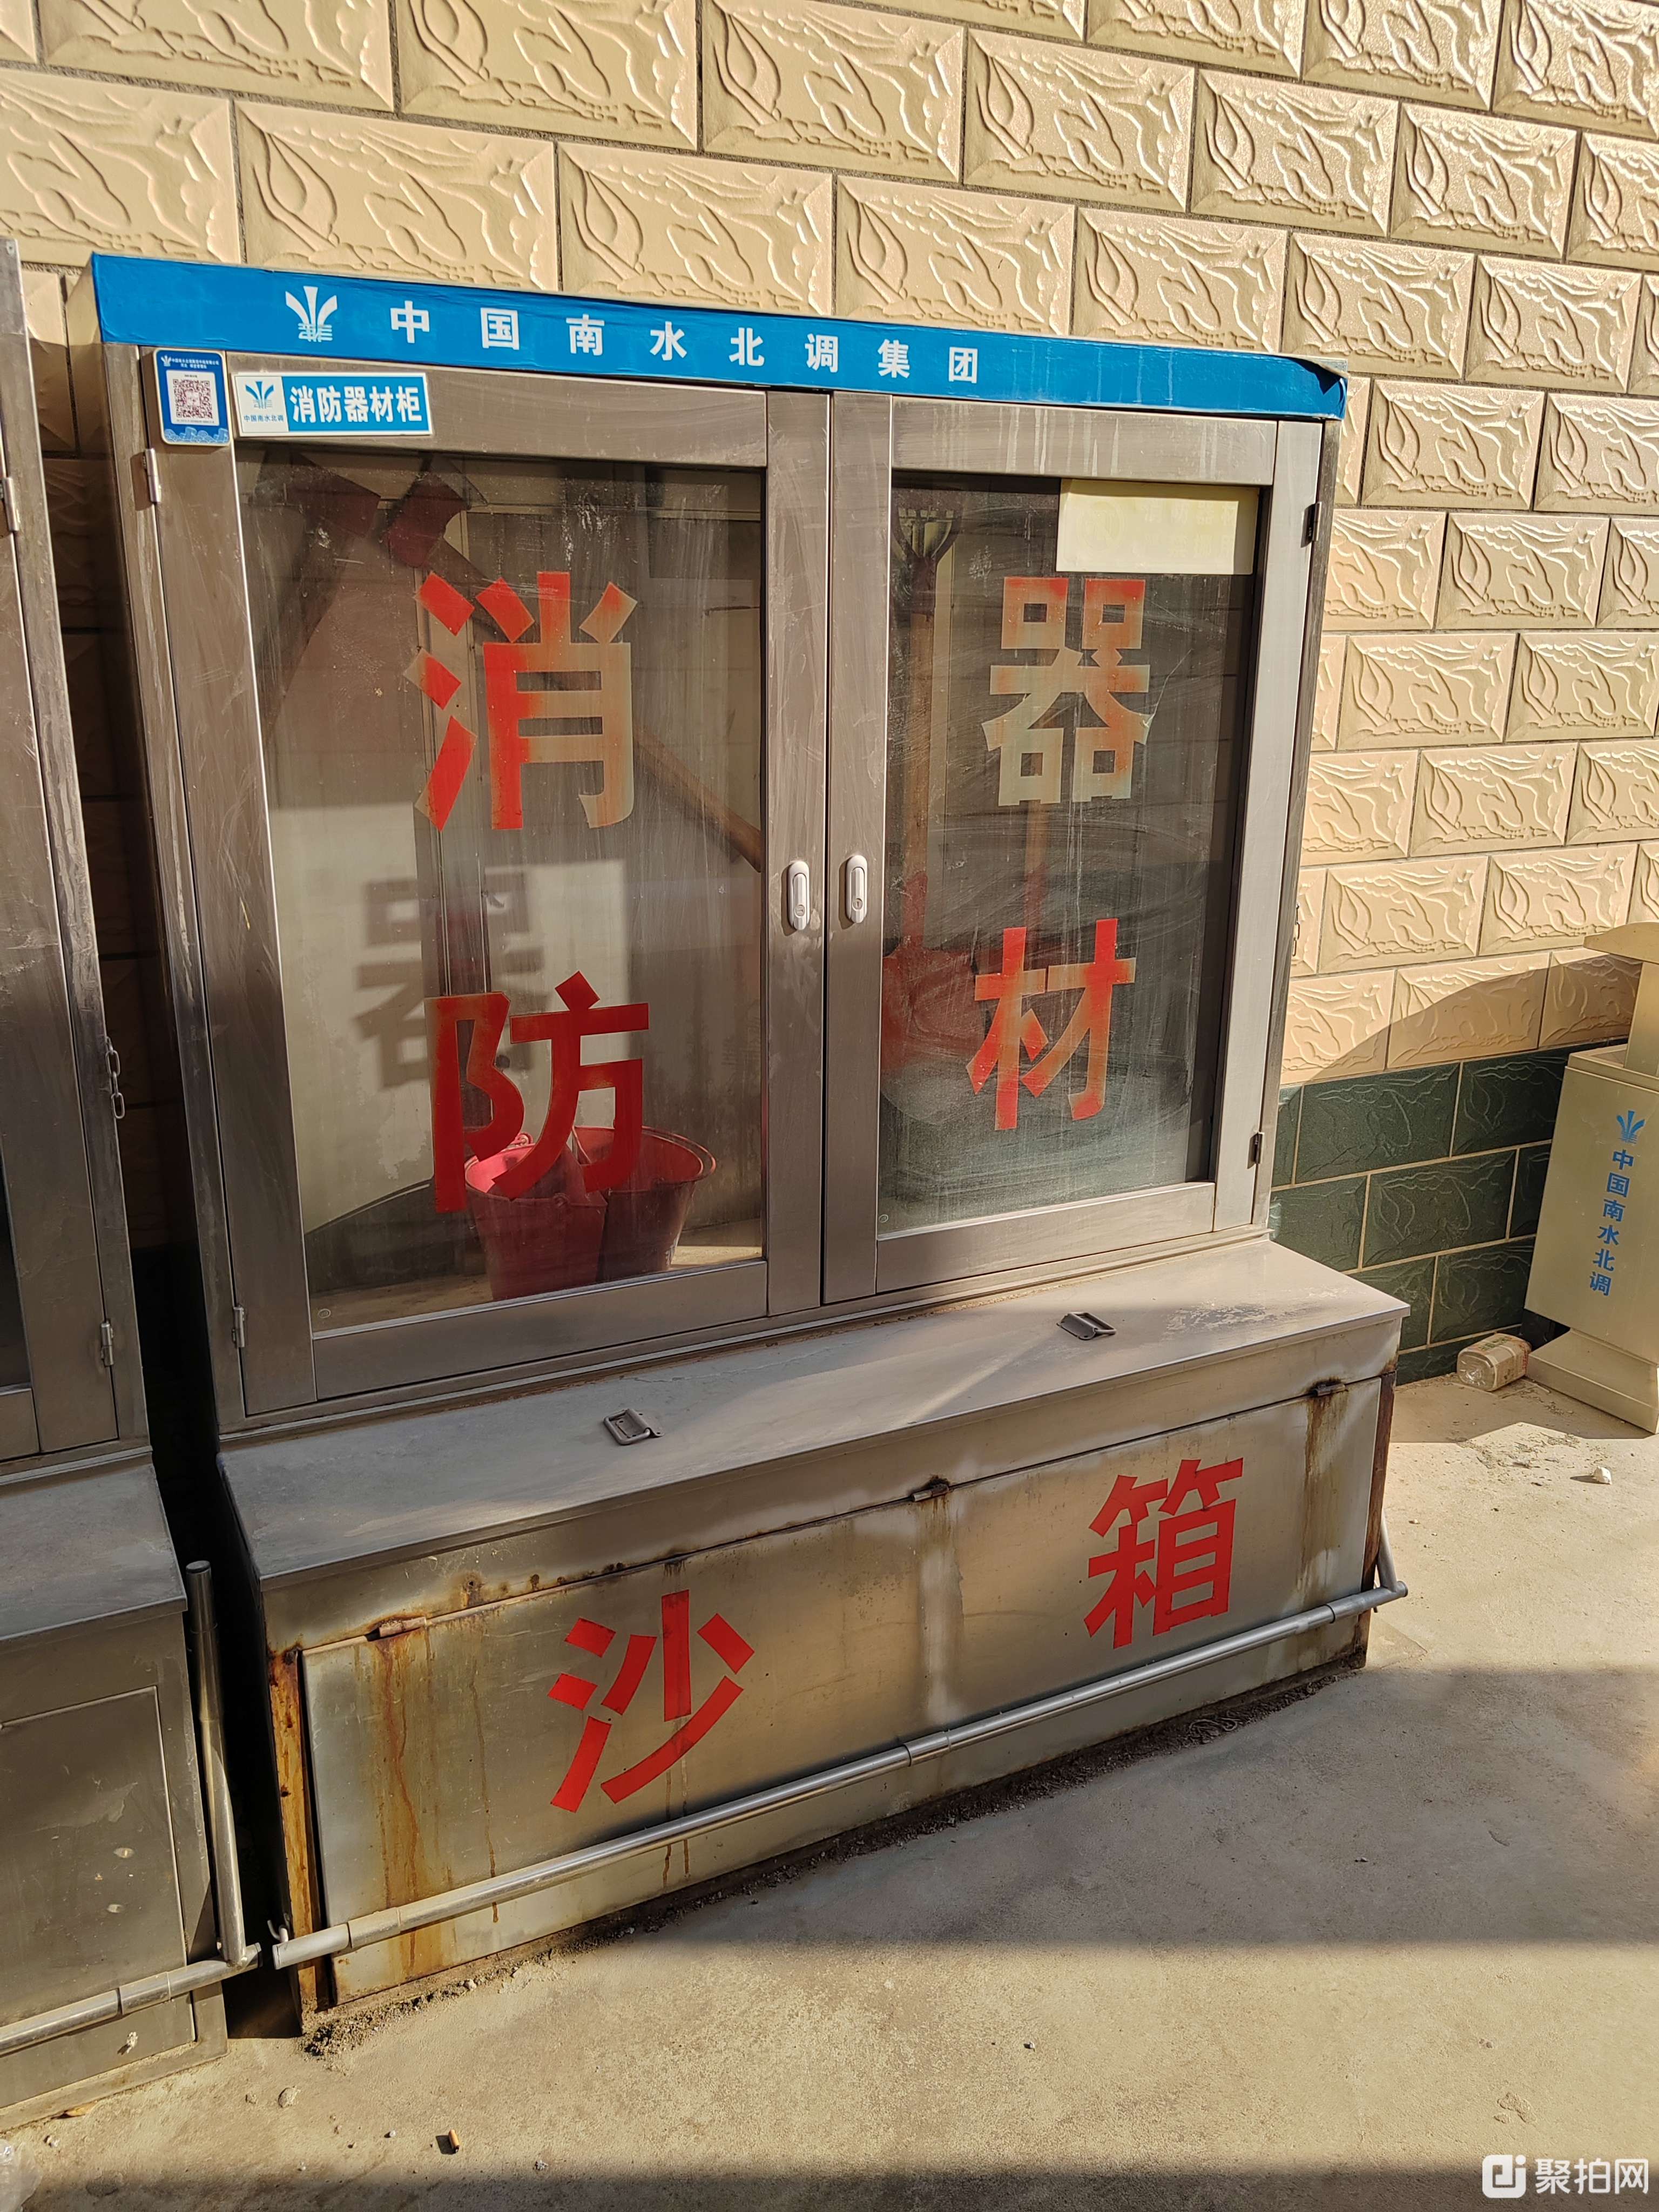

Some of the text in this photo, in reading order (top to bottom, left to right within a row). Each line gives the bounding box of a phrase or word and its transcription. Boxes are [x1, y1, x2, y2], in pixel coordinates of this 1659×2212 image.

[390, 300, 979, 384] 中国南水北调集团
[244, 414, 284, 423] 中国南水北调
[289, 385, 423, 423] 消防器材柜
[1589, 1149, 1634, 1297] 中国南水北调
